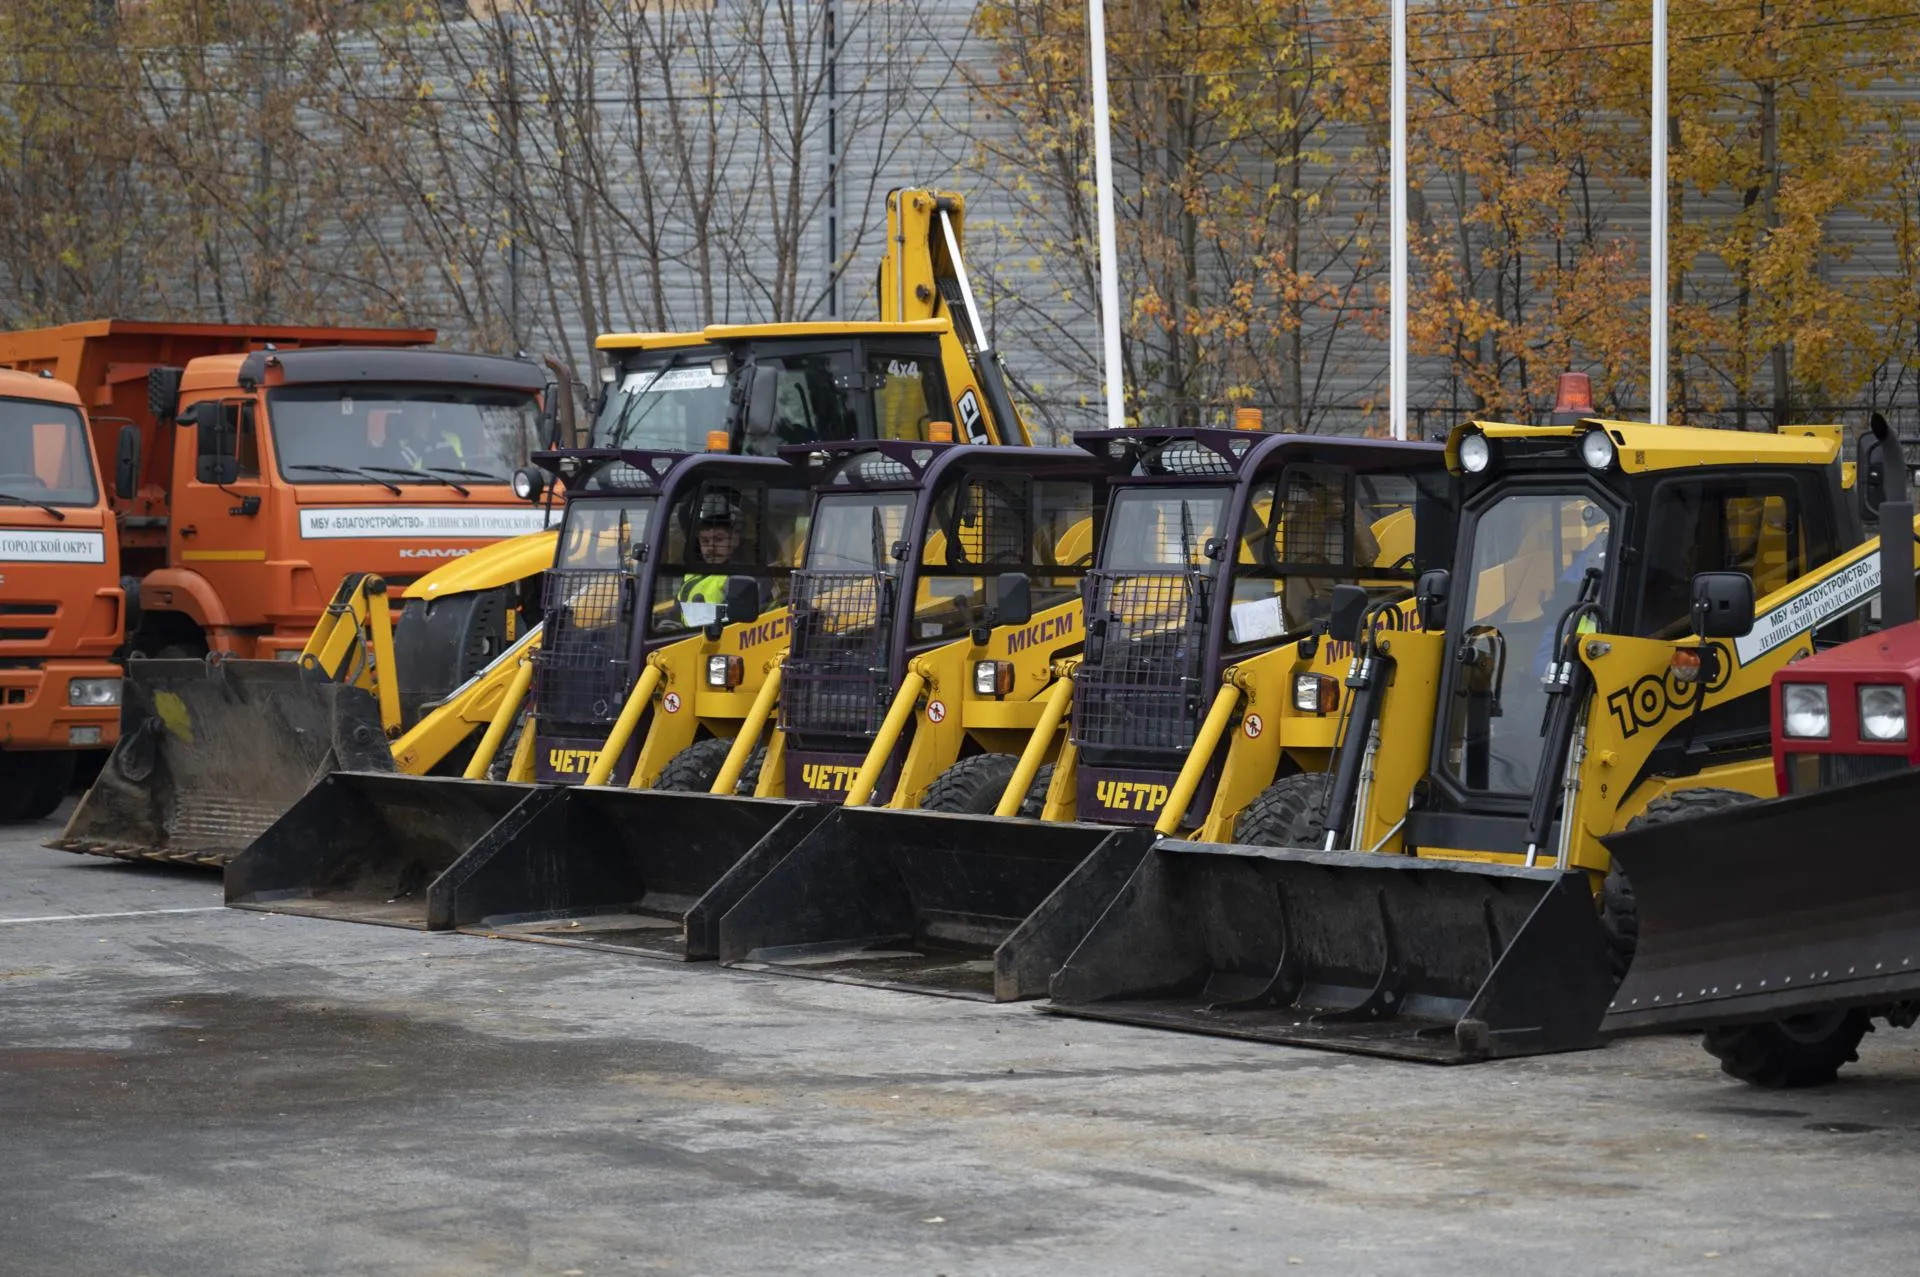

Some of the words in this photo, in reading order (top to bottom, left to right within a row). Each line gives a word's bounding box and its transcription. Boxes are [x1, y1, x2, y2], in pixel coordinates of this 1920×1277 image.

[310, 518, 329, 530] МБУ
[332, 514, 424, 529] «БЛАГОУСТРОЙСТВО»
[426, 515, 480, 529] ЛЕНИНСКИЙ
[482, 515, 532, 530] ГОРОДСКОЙ
[2, 538, 61, 553] ГОРОДСКОЙ
[63, 541, 94, 554] ОКРУГ
[400, 548, 479, 558] KAMA
[1769, 608, 1788, 628] МБУ
[1789, 562, 1872, 617] «БЛАГОУСТРОЙСТВО»
[1760, 611, 1813, 651] ЛЕНИНСКИЙ
[1813, 580, 1863, 620] ГОРОДСКОЙ
[1863, 571, 1880, 590] ОКР
[1007, 612, 1073, 656] МКСМ
[802, 764, 863, 792] ЧЕТР
[1096, 780, 1169, 811] ЧЕТР
